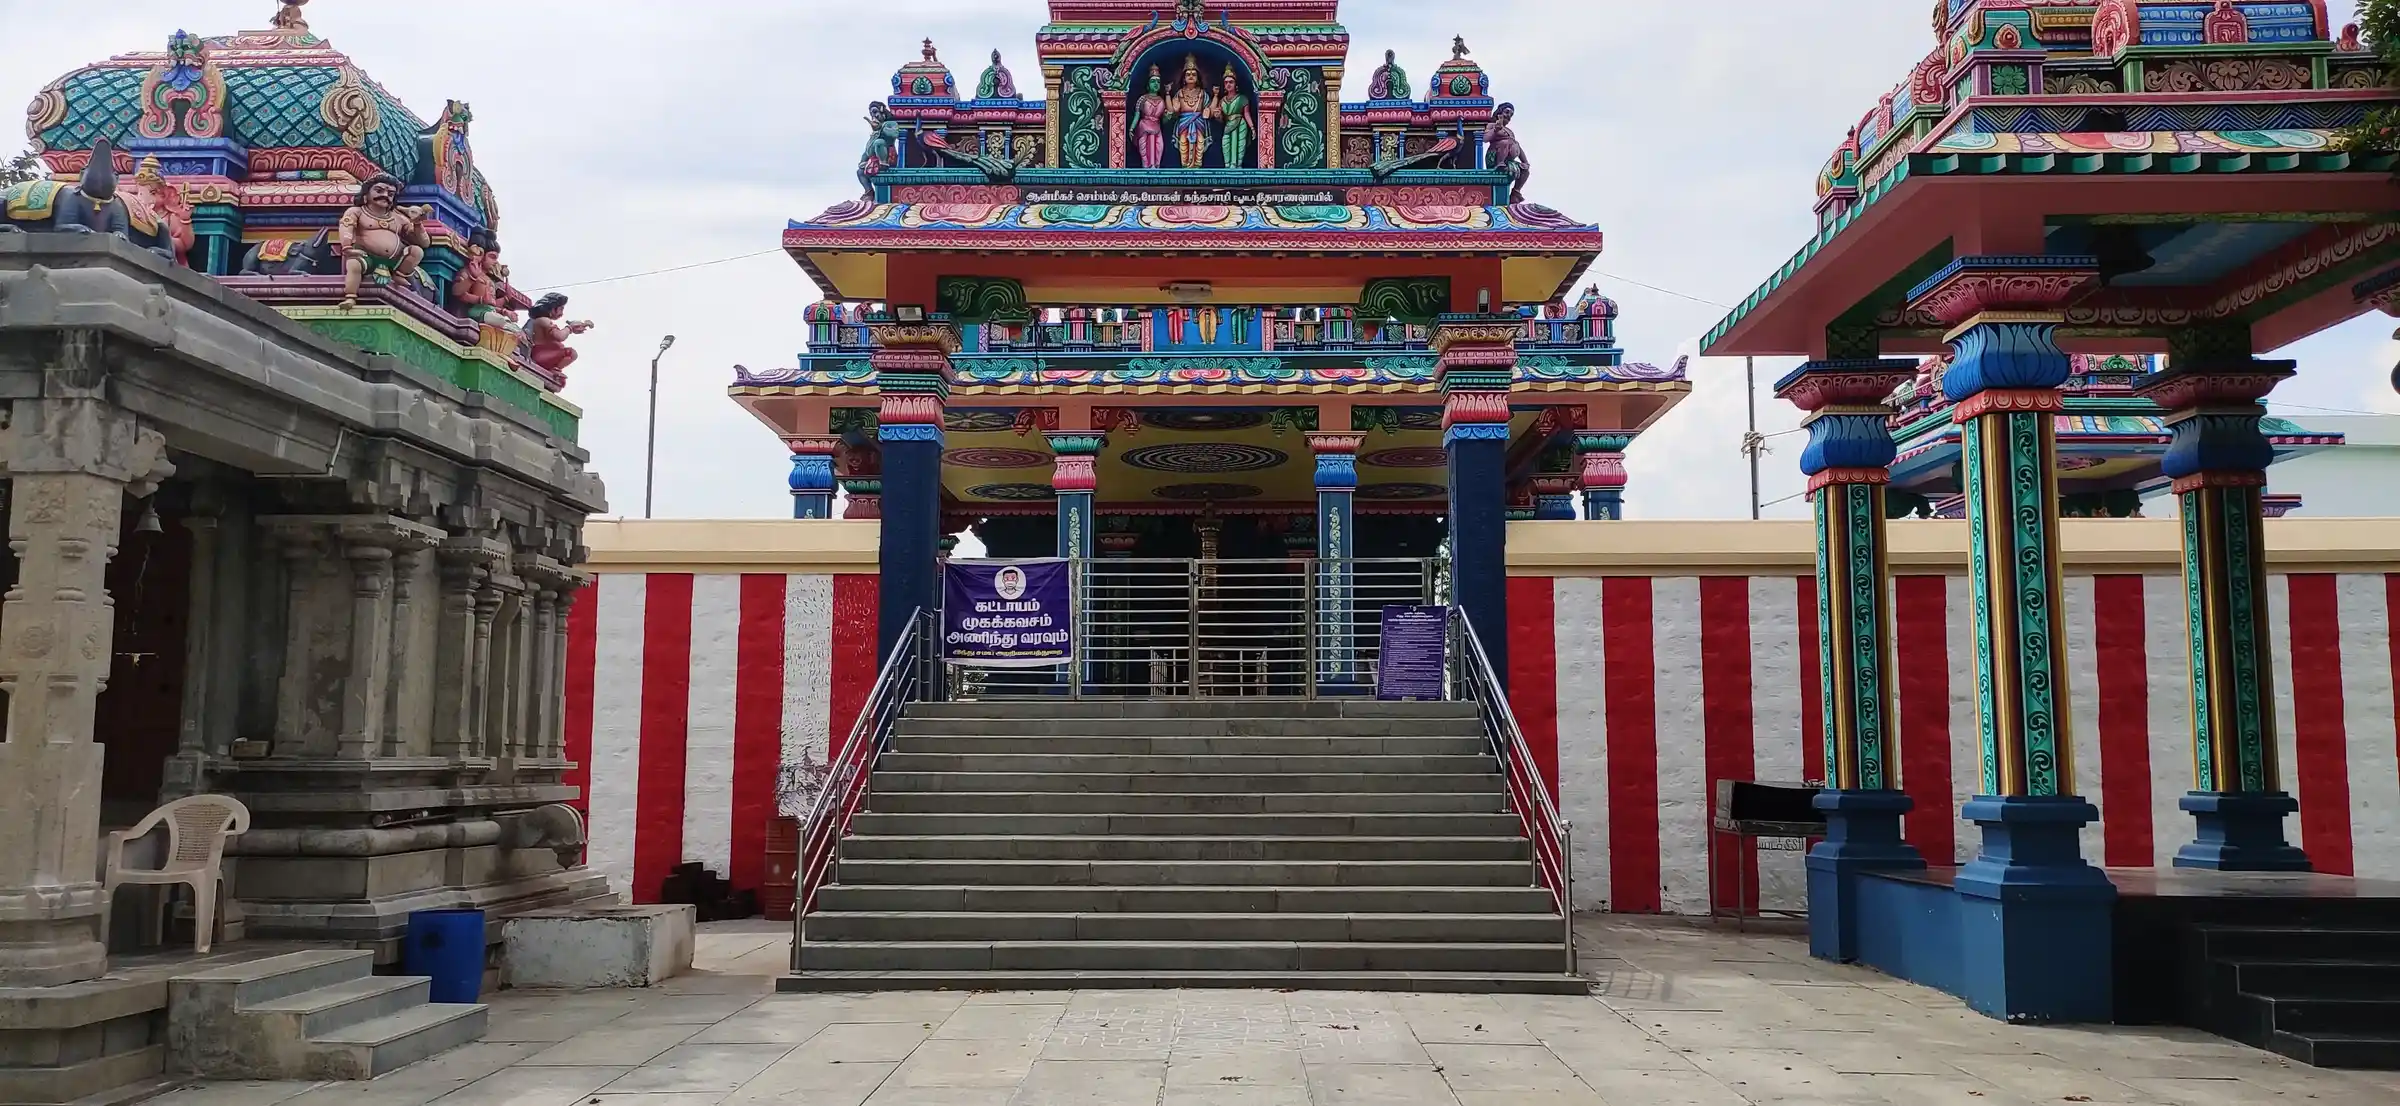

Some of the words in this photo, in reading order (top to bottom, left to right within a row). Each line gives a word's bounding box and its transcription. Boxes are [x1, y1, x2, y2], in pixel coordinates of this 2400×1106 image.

[1026, 190, 1075, 202] ஆன்மீகச்
[1076, 190, 1118, 202] செம்மல்
[1119, 191, 1181, 203] திரு.மோகன்
[1183, 191, 1231, 203] கந்தசாமி
[1256, 191, 1334, 206] தோரணவாயில்
[975, 598, 1041, 612] கட்டாயம்
[963, 614, 1052, 630] முகக்கவசம்
[947, 632, 1017, 648] அணிந்து
[1020, 629, 1069, 645] வரவும்
